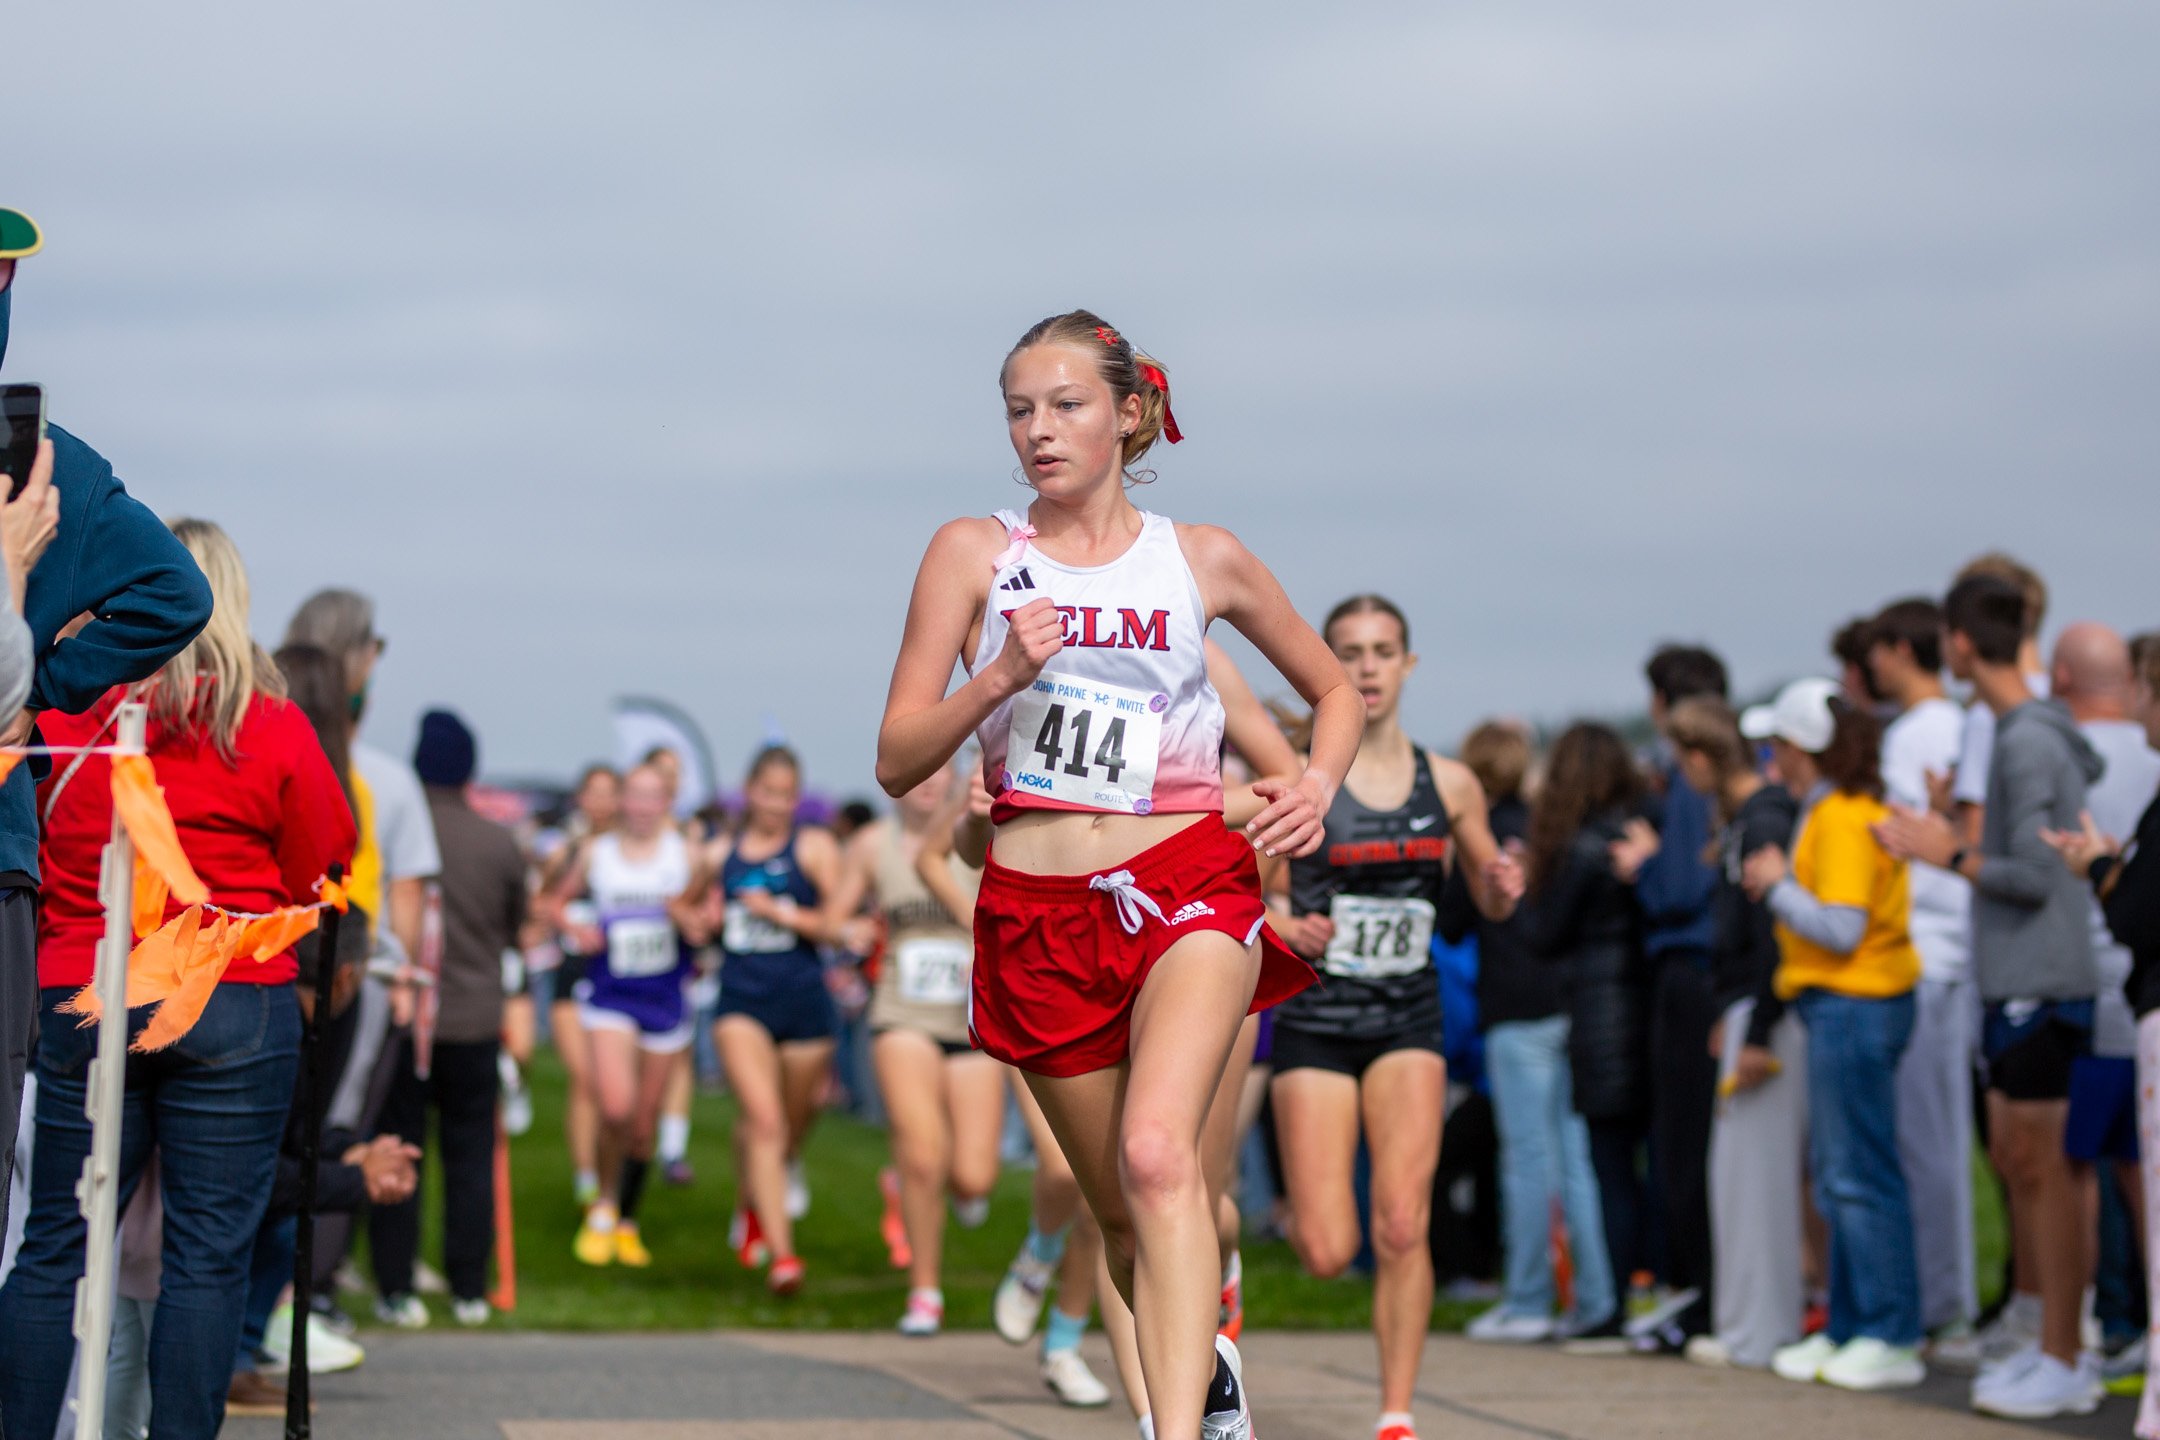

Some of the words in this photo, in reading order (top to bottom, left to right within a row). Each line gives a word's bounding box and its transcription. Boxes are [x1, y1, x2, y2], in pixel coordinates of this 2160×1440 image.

[1000, 605, 1171, 651] ELM
[1032, 679, 1055, 694] JOHN
[1057, 683, 1087, 700] PAYNE
[1116, 696, 1145, 714] INVITE
[1034, 703, 1127, 783] 414
[1016, 771, 1053, 791] HOKA
[1171, 907, 1216, 926] adidas
[1353, 917, 1413, 957] 178
